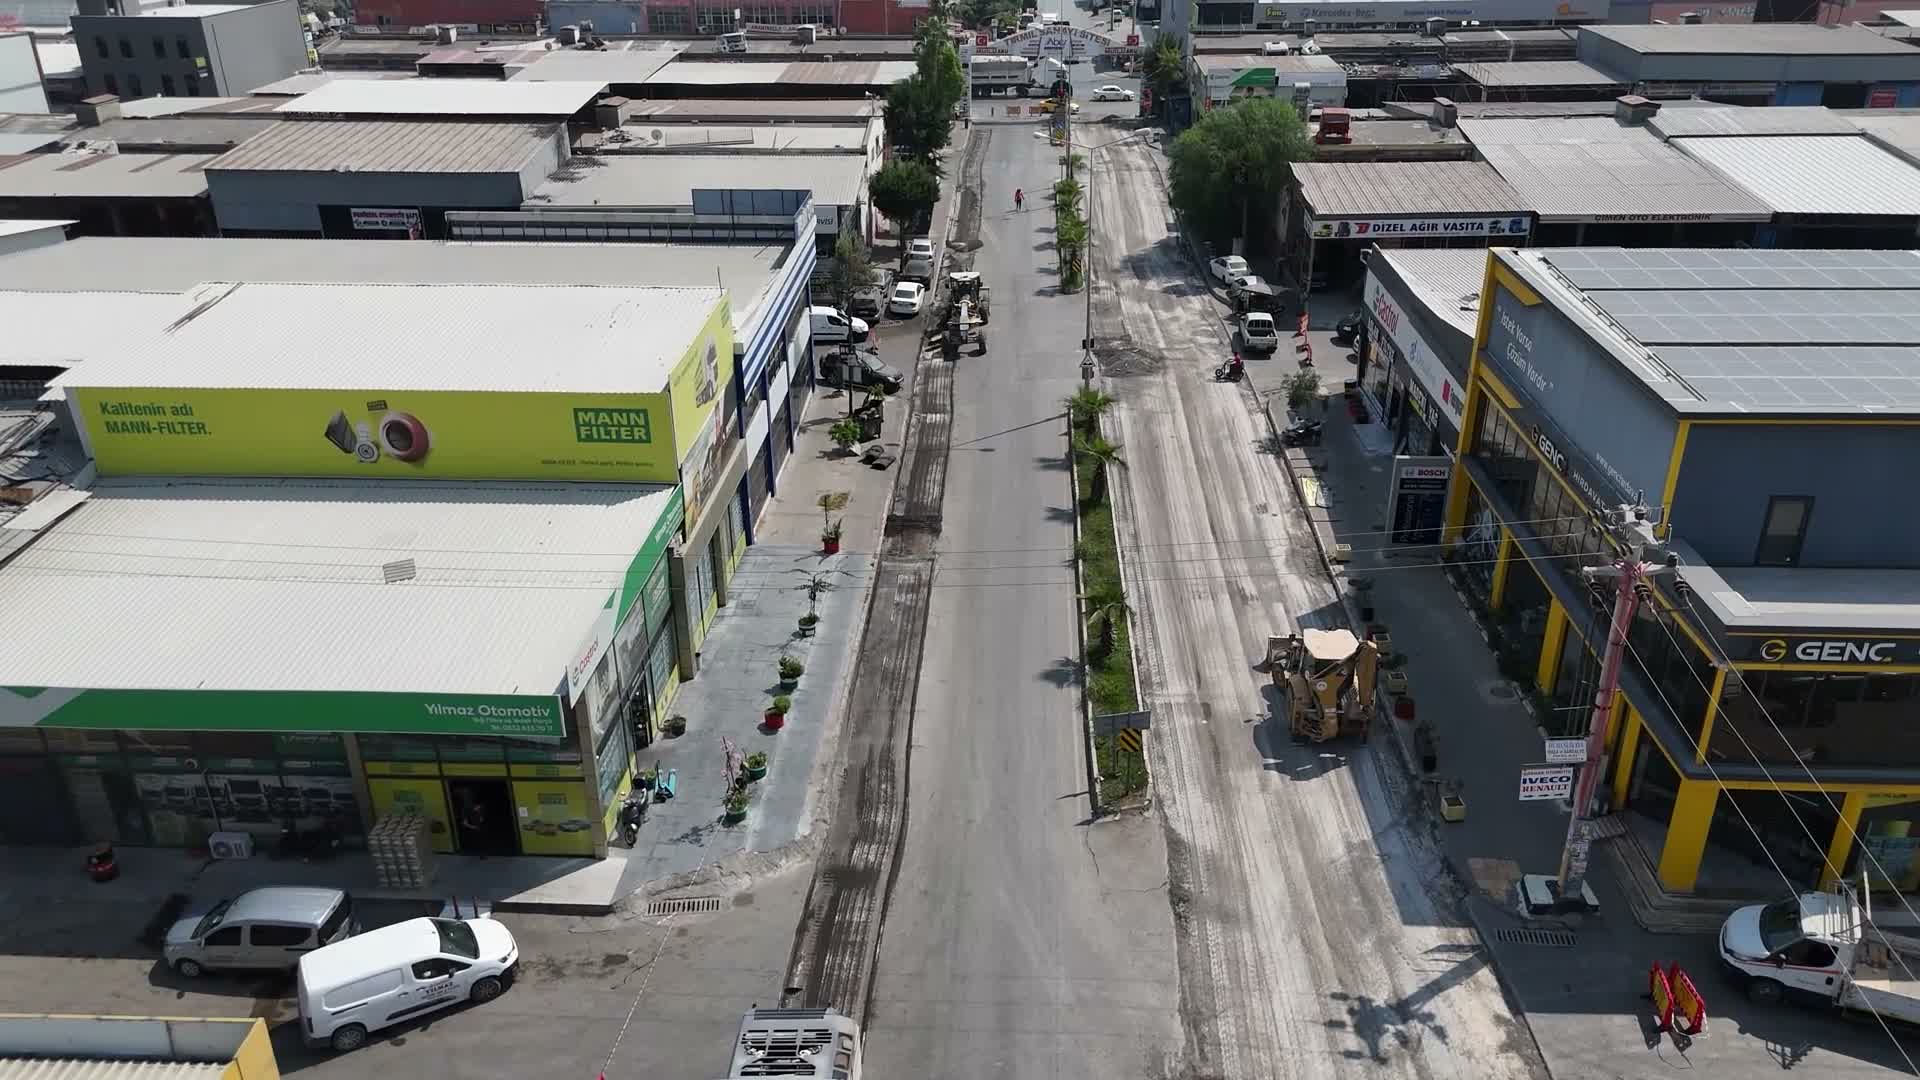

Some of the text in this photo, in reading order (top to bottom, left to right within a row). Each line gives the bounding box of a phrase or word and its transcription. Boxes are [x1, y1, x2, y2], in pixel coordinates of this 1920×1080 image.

[1409, 220, 1439, 232] AĞIR
[1443, 222, 1484, 232] VASITA
[99, 401, 194, 417] Kalitenin adı
[576, 411, 646, 425] MANN
[104, 420, 213, 436] MANN-FILTER.
[579, 426, 648, 440] FILTER
[1417, 469, 1446, 477] BOSCH
[424, 703, 551, 717] Yılmaz Otomotiv
[1522, 775, 1571, 785] IVECO
[1522, 784, 1569, 793] RENAULT
